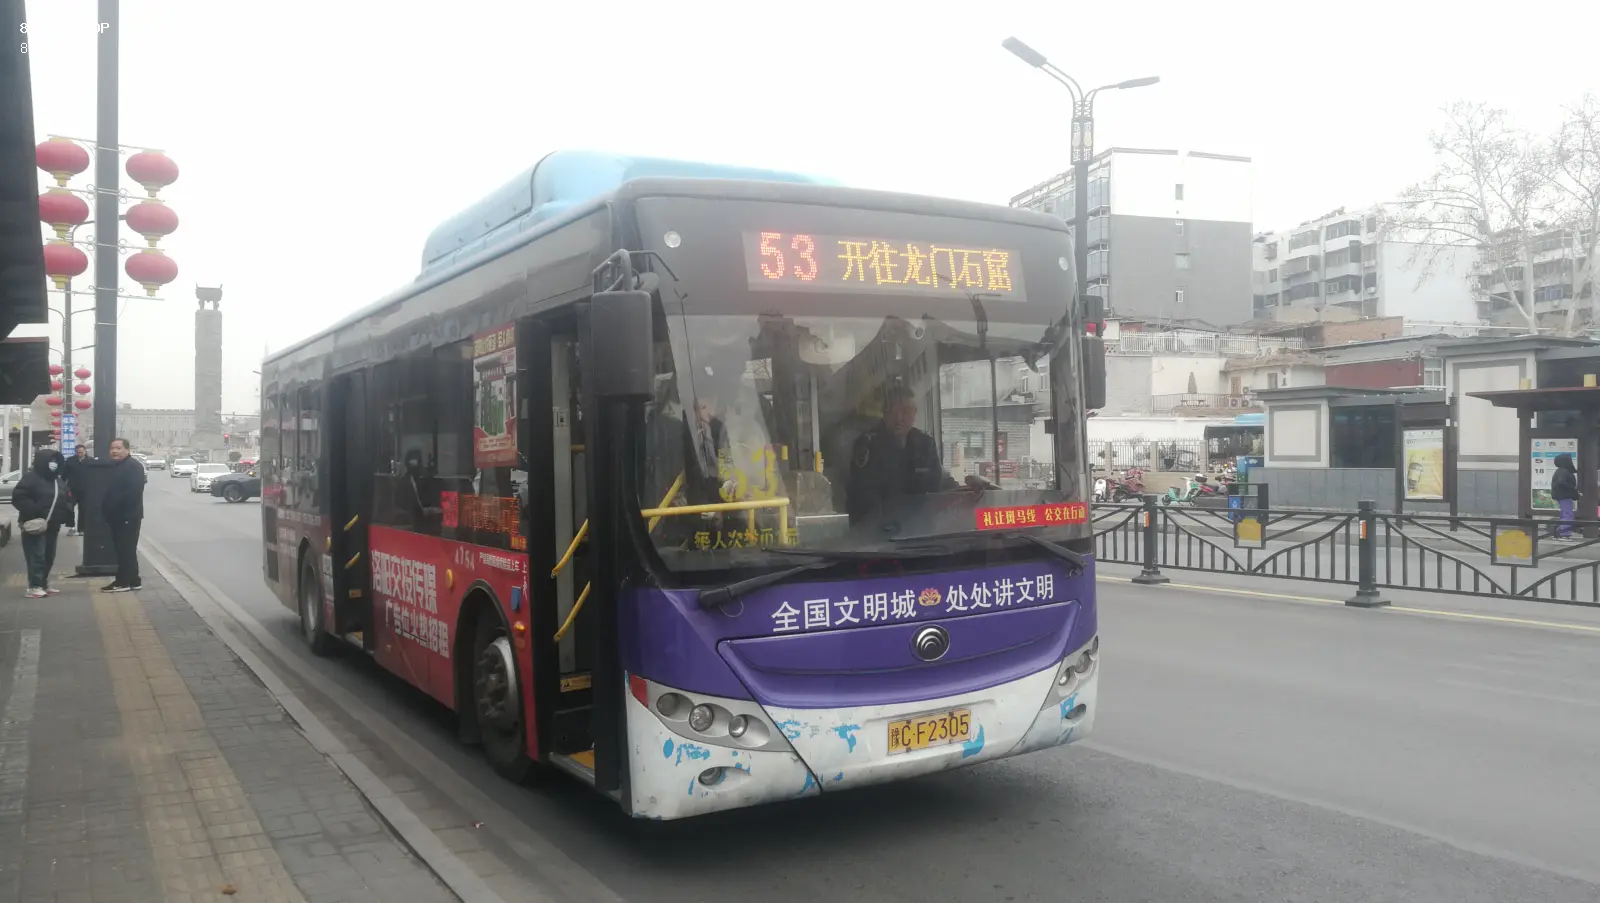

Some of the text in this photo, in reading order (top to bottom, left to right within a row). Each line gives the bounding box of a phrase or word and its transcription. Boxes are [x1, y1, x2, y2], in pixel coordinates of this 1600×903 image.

[760, 231, 1012, 291] 53 开往龙门石窟
[983, 505, 1085, 526] 礼让斑马线 公交在行动
[371, 548, 438, 614] 洛阳交投传媒
[771, 573, 1054, 633] 全国文明城 处处讲文明
